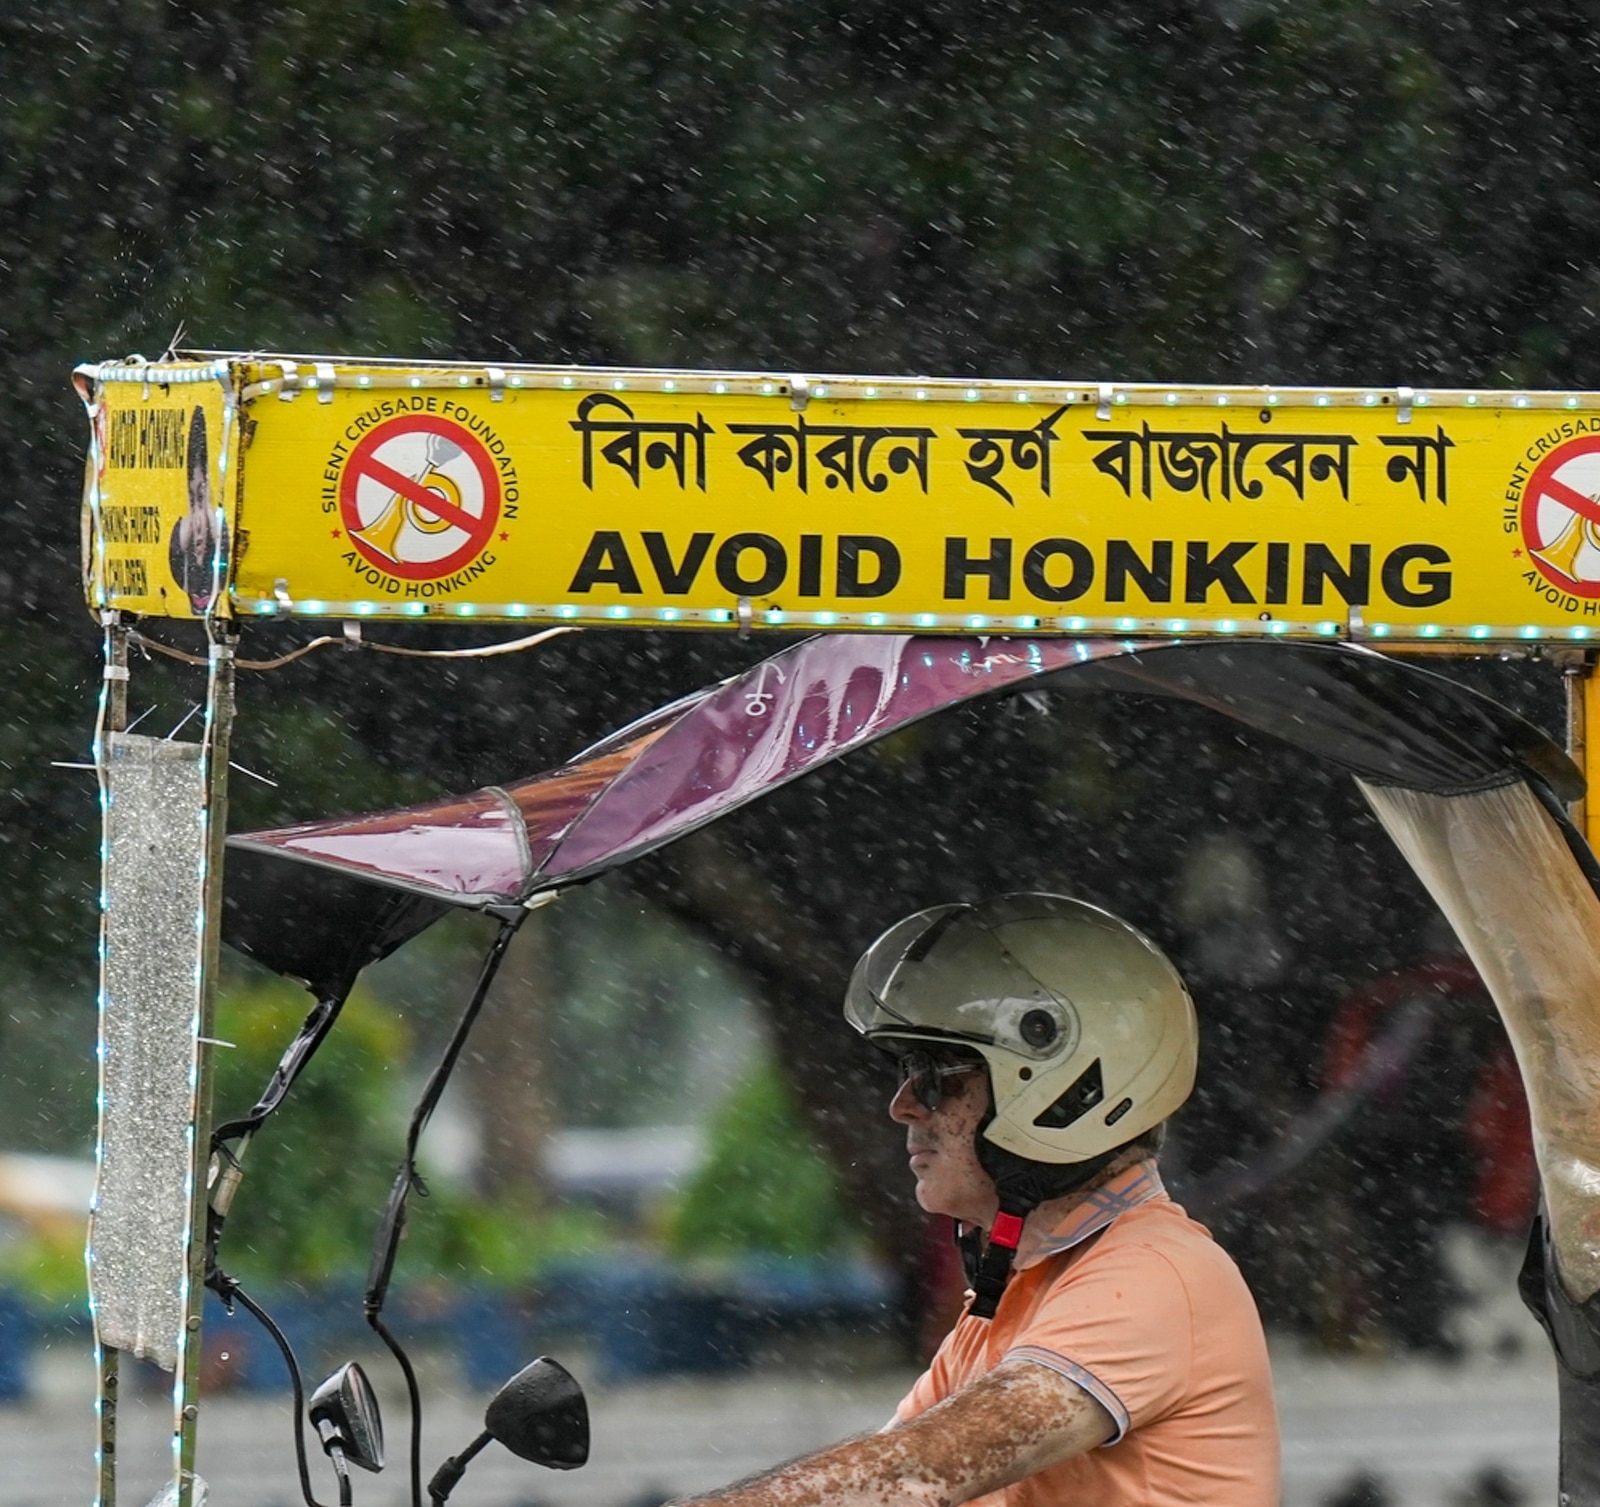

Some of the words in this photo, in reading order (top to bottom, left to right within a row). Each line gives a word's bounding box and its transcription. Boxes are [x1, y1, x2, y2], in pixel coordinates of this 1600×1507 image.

[109, 409, 138, 469] AVOID
[140, 408, 185, 469] HONKING
[322, 441, 349, 513] SILENT
[345, 396, 438, 441] CRUSADE
[442, 400, 519, 519] FOUNDATION
[568, 393, 715, 493] বিনা
[726, 413, 938, 496] কারনে
[1080, 419, 1359, 503] বাজাবেন
[1377, 423, 1456, 506] না
[1504, 462, 1529, 534] SILENT
[341, 551, 401, 594] AVOID
[405, 551, 497, 598] HONKING
[567, 530, 901, 598] AVOID
[943, 537, 1453, 608] HONKING
[1521, 570, 1579, 613] AVOID
